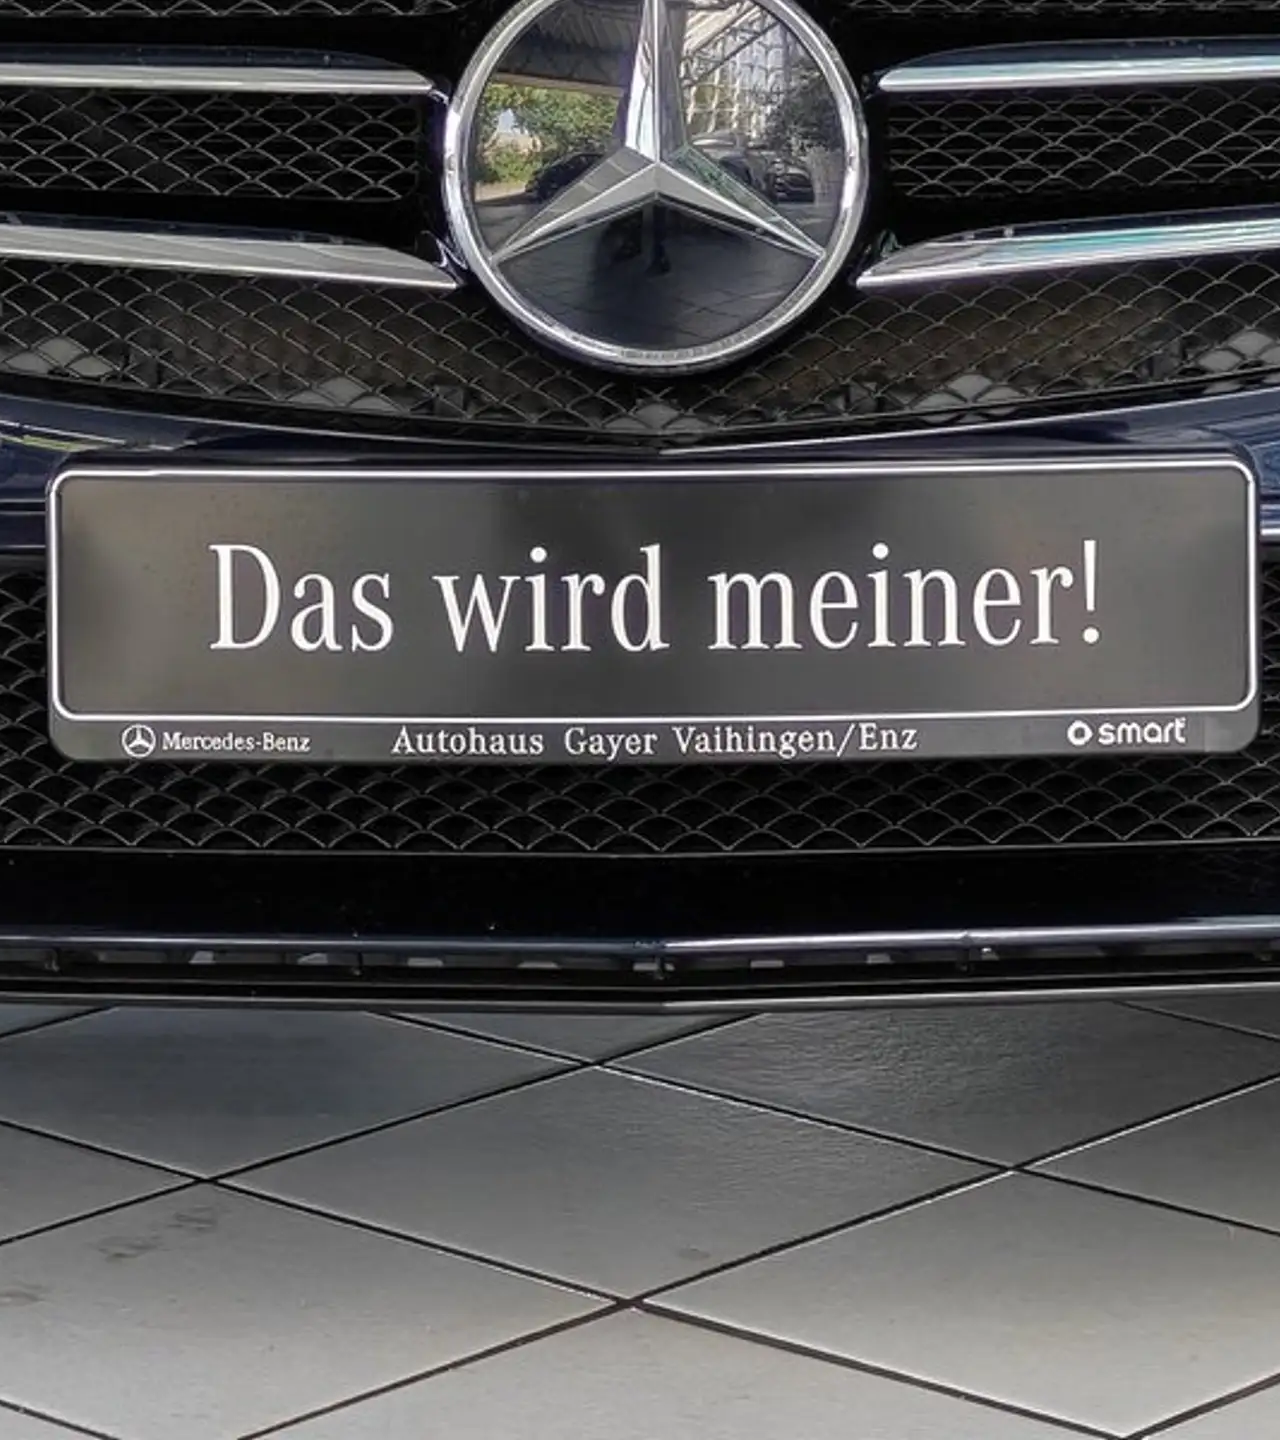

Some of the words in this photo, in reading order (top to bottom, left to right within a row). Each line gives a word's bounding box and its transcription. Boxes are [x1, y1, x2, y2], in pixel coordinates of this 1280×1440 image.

[209, 544, 393, 652] Das
[432, 544, 670, 652] wird
[708, 539, 1101, 650] meiner!
[162, 731, 311, 752] Mercedes-Benz
[391, 725, 544, 755] Autohaus
[564, 727, 658, 761] Gayer
[671, 722, 918, 760] Vaihingen/Enz
[1097, 717, 1187, 746] smart
